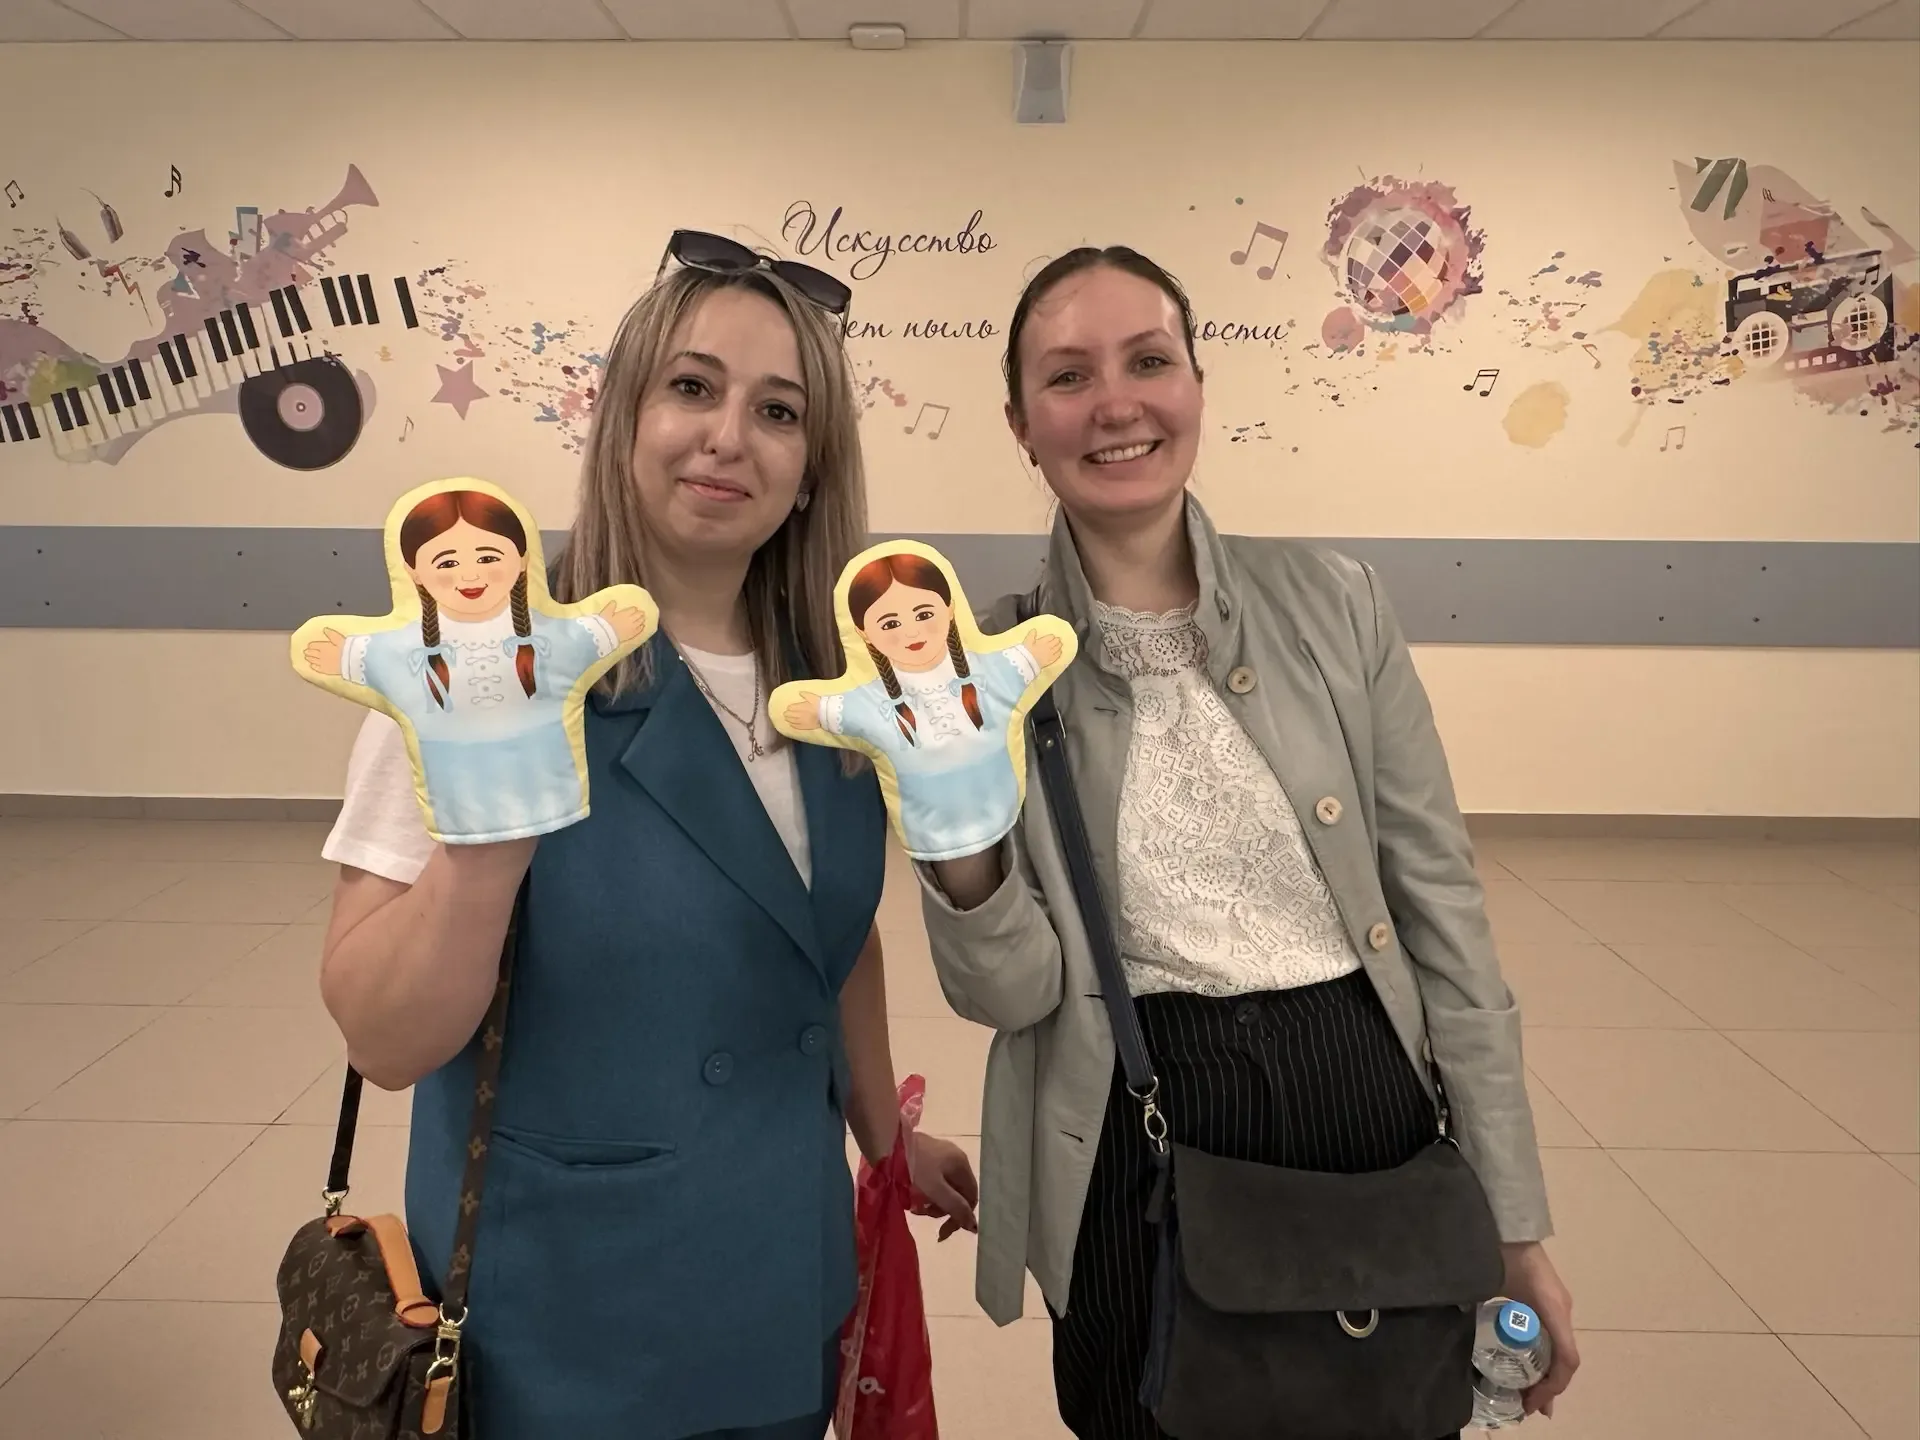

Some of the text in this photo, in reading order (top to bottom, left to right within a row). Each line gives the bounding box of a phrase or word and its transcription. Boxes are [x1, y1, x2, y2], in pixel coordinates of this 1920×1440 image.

[782, 200, 998, 281] Искусство
[845, 320, 893, 339] ет
[902, 319, 1000, 339] пыль
